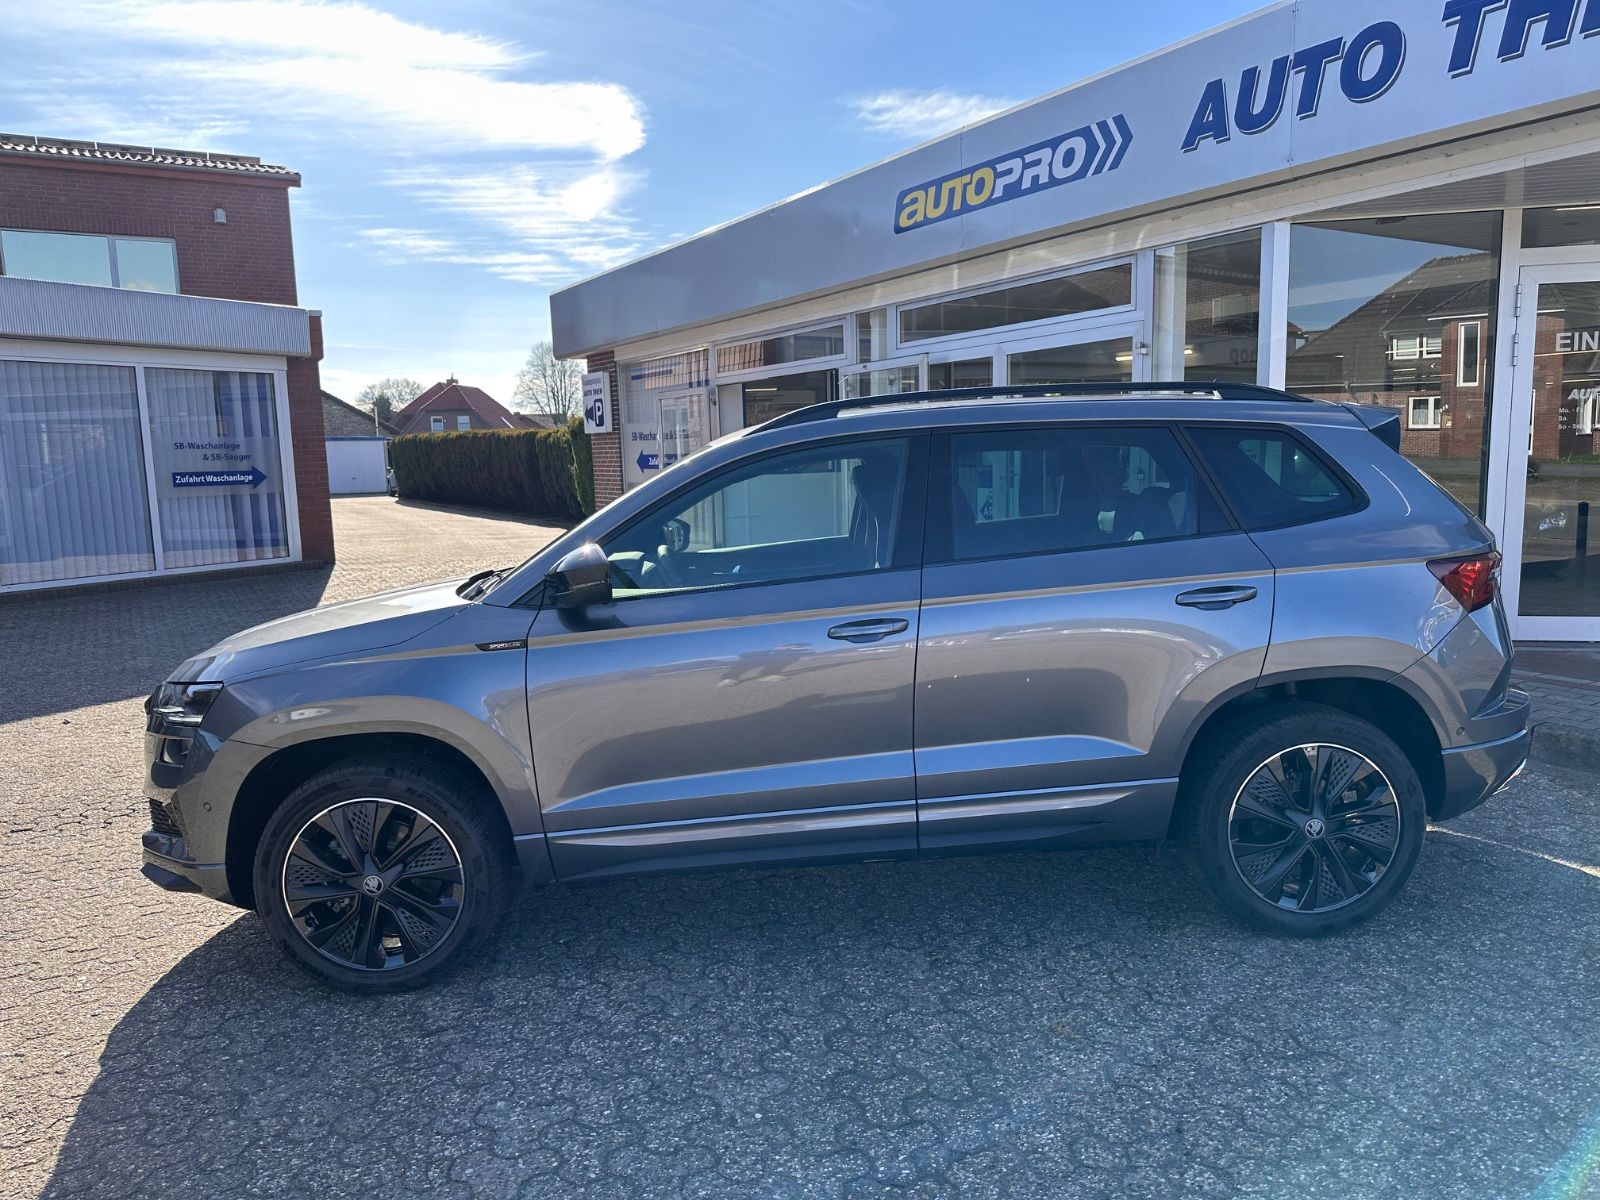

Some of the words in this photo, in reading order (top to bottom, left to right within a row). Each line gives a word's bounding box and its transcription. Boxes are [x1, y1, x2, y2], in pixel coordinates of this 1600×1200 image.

[1181, 20, 1406, 153] AUTO
[1555, 331, 1599, 352] EIN
[595, 401, 603, 425] P
[174, 442, 241, 451] SB-Waschanlage
[203, 453, 210, 461] &
[211, 453, 251, 462] SB-Sauger
[175, 475, 205, 483] Zufahrt
[205, 473, 253, 483] Waschanlage
